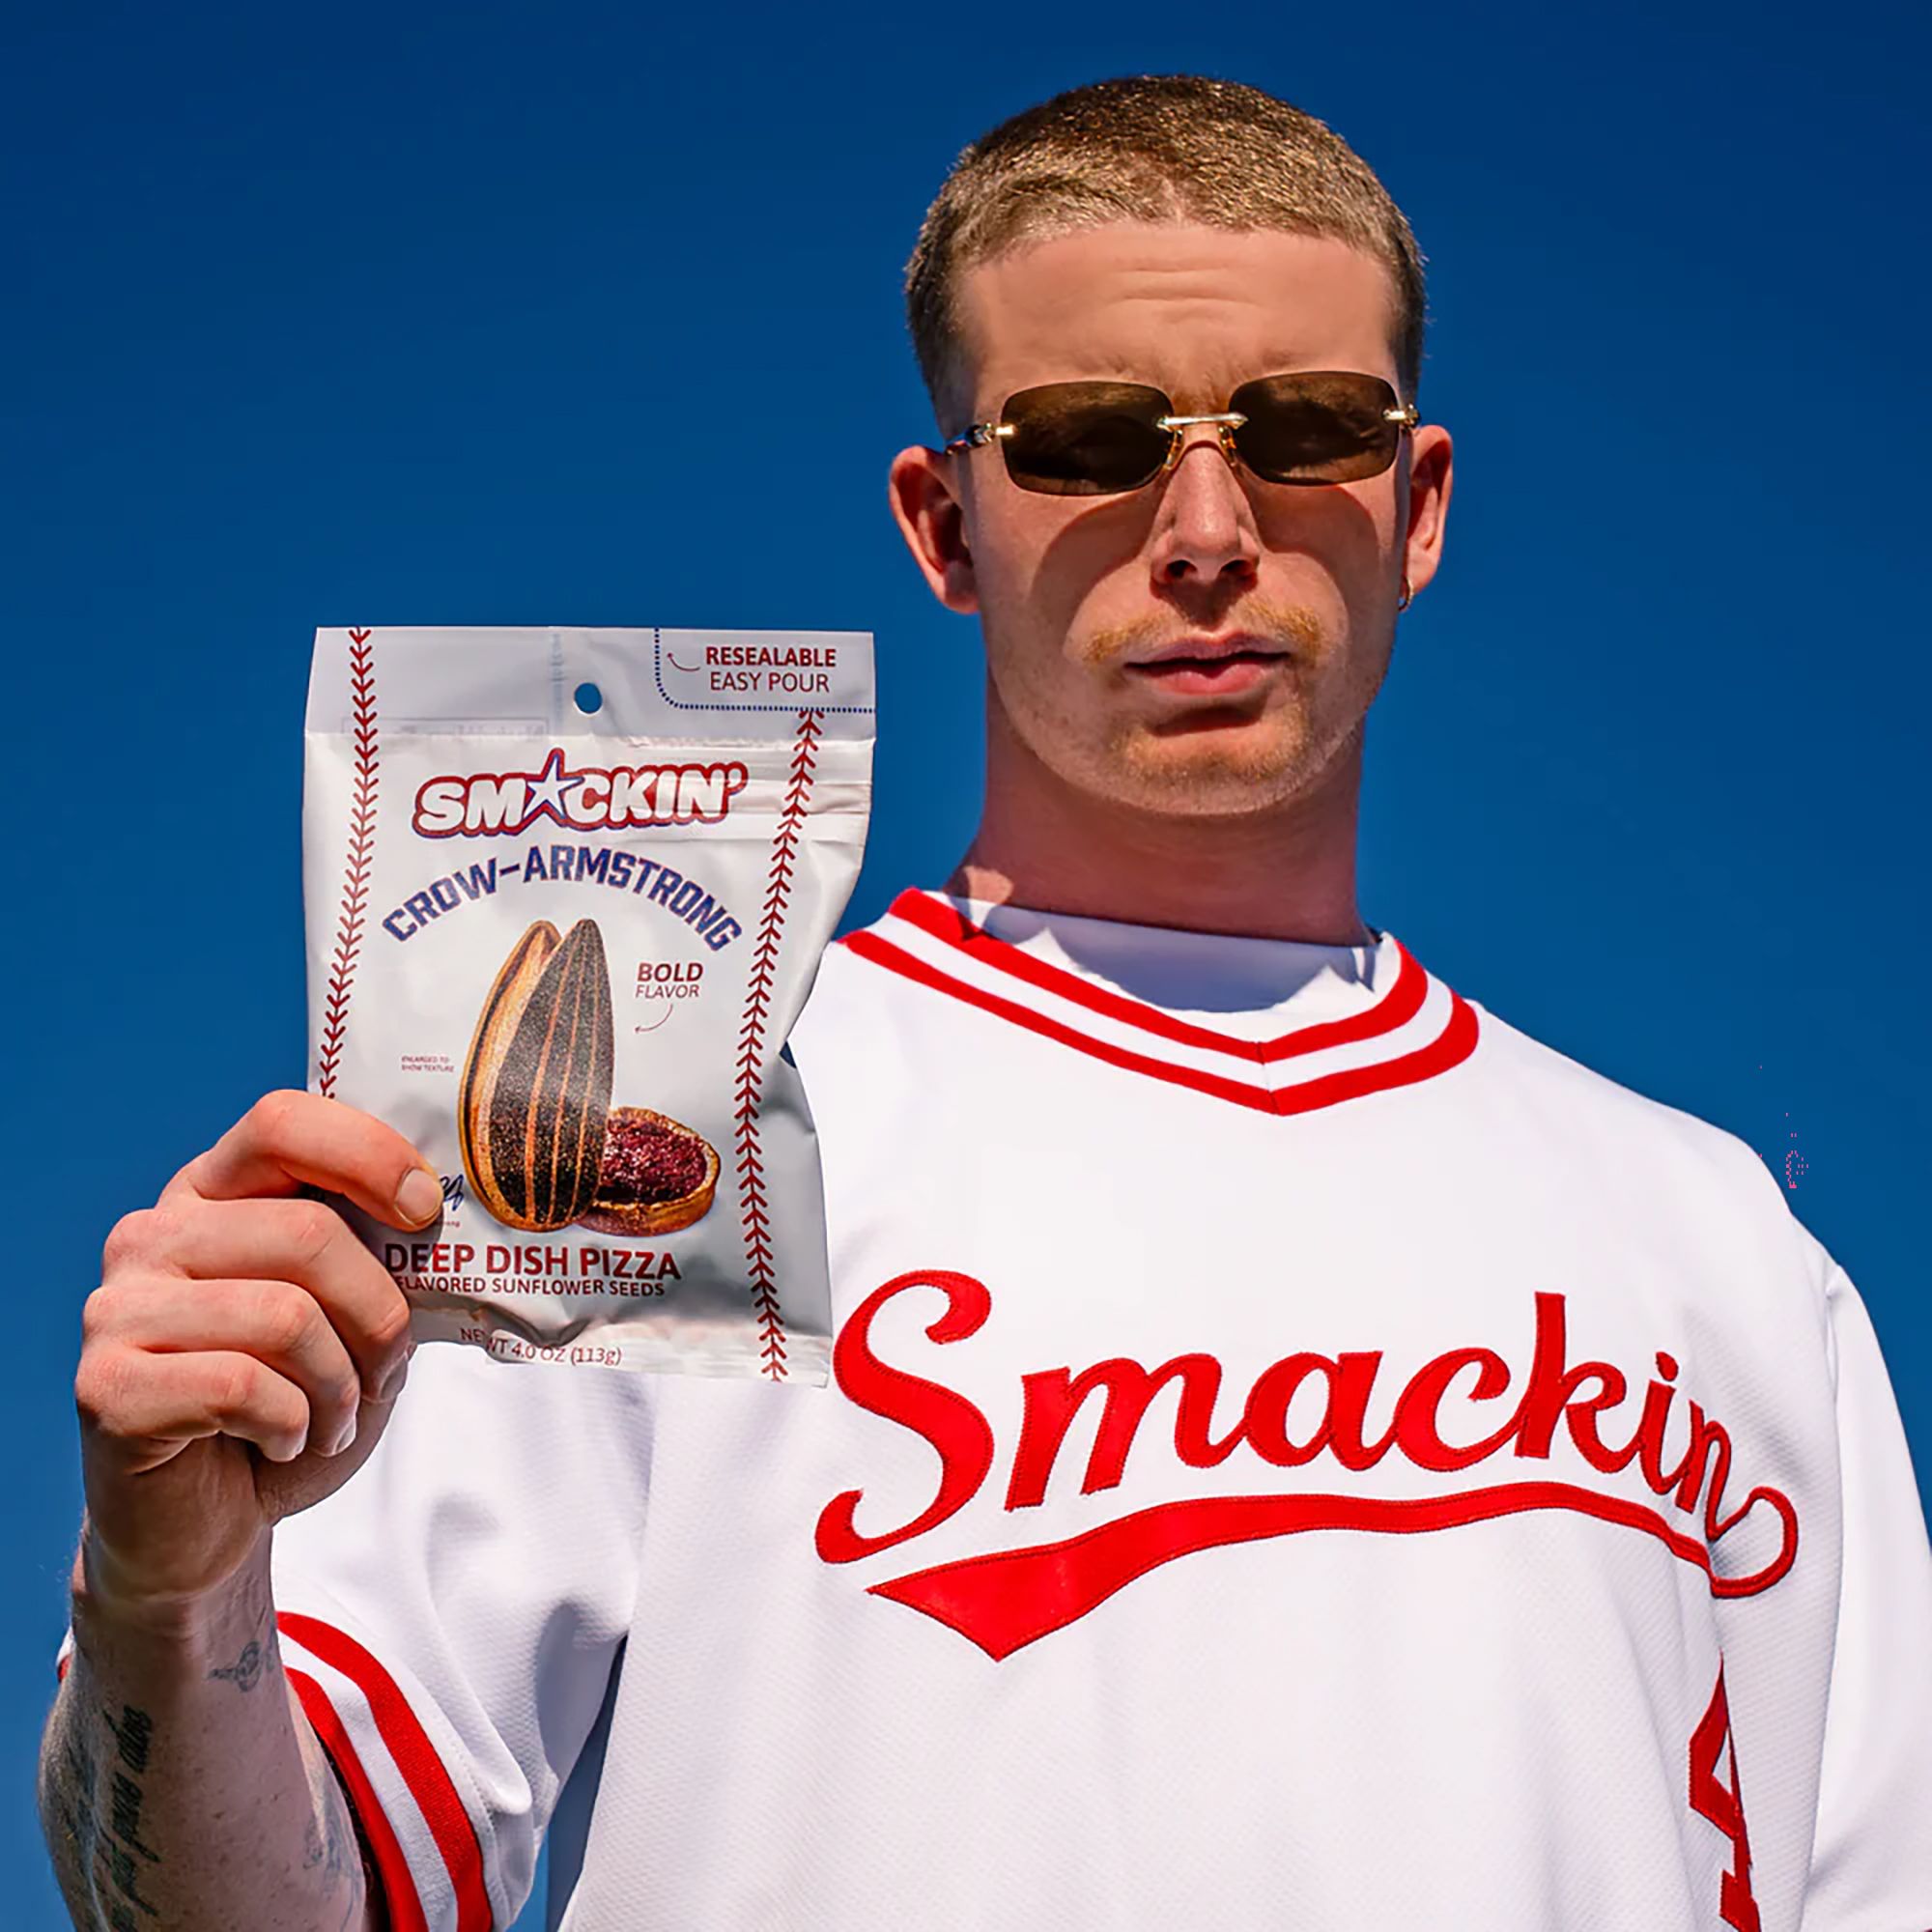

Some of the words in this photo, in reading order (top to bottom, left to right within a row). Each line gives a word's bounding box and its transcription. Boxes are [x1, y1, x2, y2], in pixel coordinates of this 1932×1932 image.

[705, 646, 837, 667] RESEALABLE
[710, 671, 762, 691] EASY
[768, 671, 830, 693] POUR
[382, 844, 743, 952] CROW-ARMSTRONG
[637, 962, 703, 982] BOLD
[635, 984, 700, 999] FLAVOR
[385, 1242, 474, 1275] DEEP
[486, 1244, 568, 1276] DISH
[581, 1247, 681, 1281] PIZZA
[396, 1275, 485, 1293] FLAVORED
[492, 1276, 604, 1295] SUNFLOWER
[609, 1280, 666, 1297] SEEDS
[460, 1326, 485, 1343] NE
[511, 1342, 535, 1360] 4.0
[539, 1347, 567, 1364] OZ
[571, 1347, 622, 1368] (113g)
[814, 1270, 1800, 1599] Smackin
